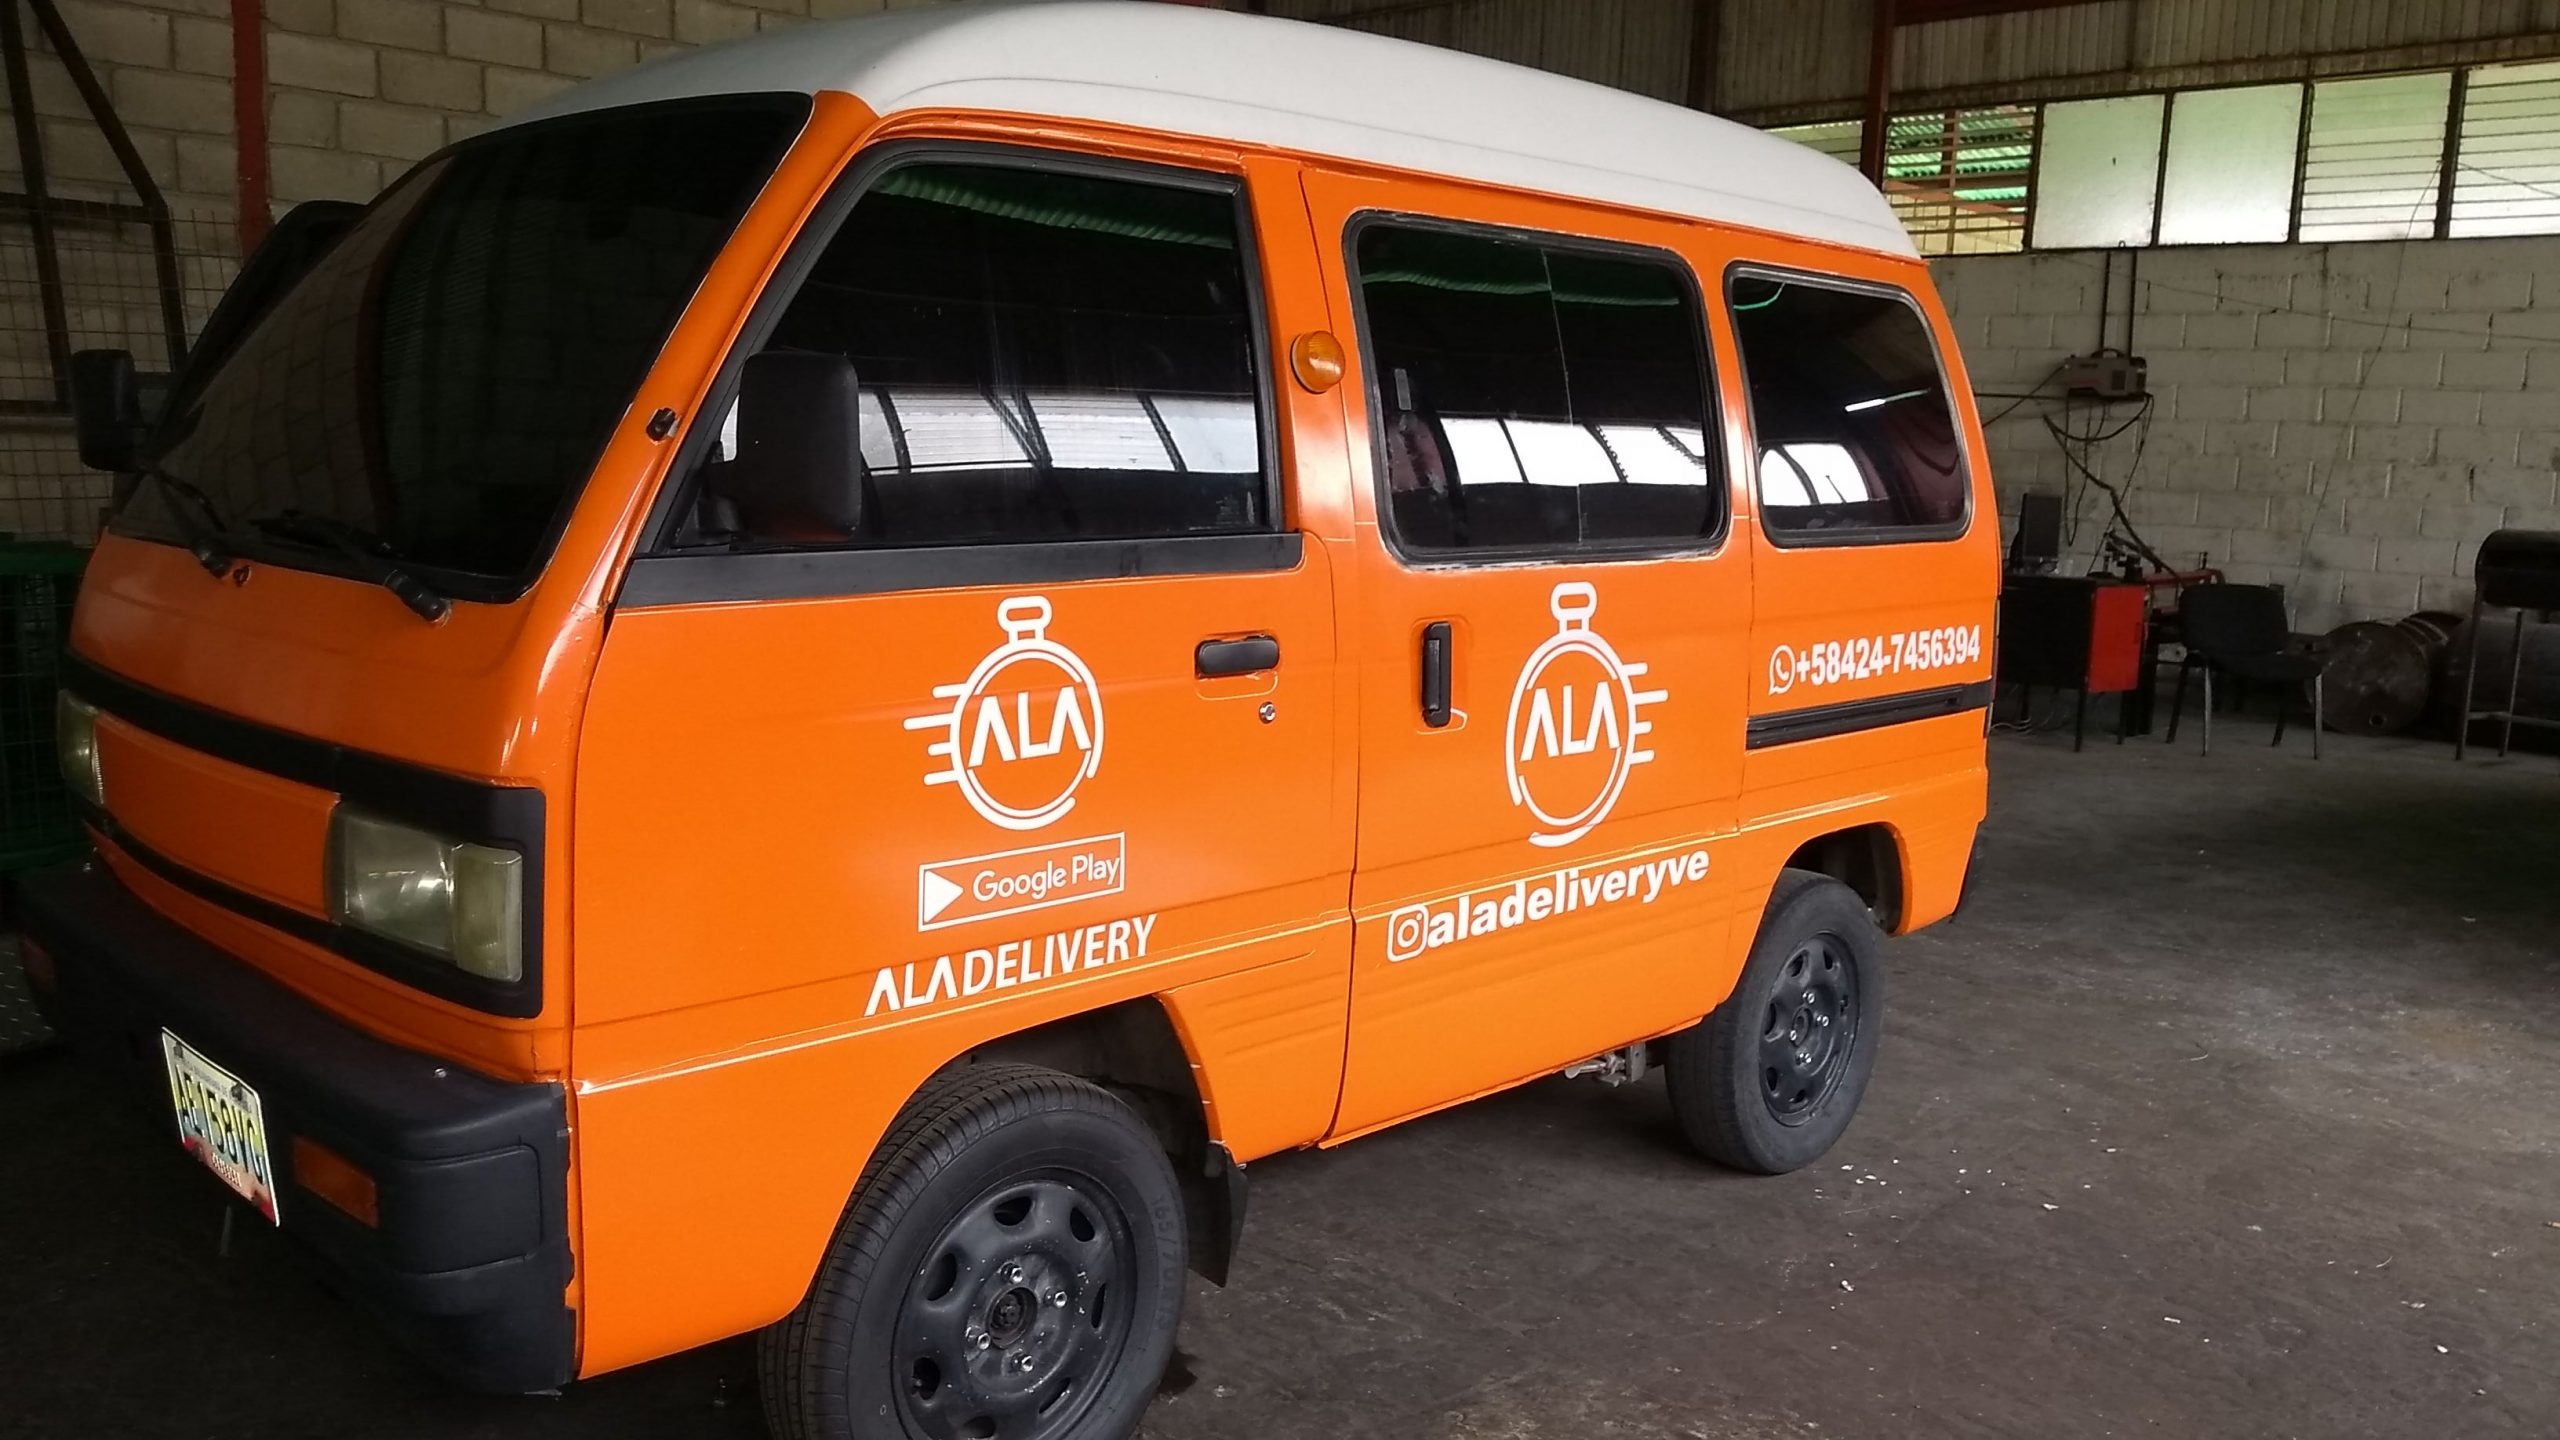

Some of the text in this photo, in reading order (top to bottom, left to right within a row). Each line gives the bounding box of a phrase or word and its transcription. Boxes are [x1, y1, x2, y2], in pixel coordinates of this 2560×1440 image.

[1796, 624, 1981, 686] +58424-7456394
[968, 685, 1092, 768] ALA
[1519, 680, 1622, 762] ALA
[973, 853, 1121, 901] Google Play
[1426, 849, 1710, 949] aladeliveryve
[176, 1064, 265, 1186] AE158VG
